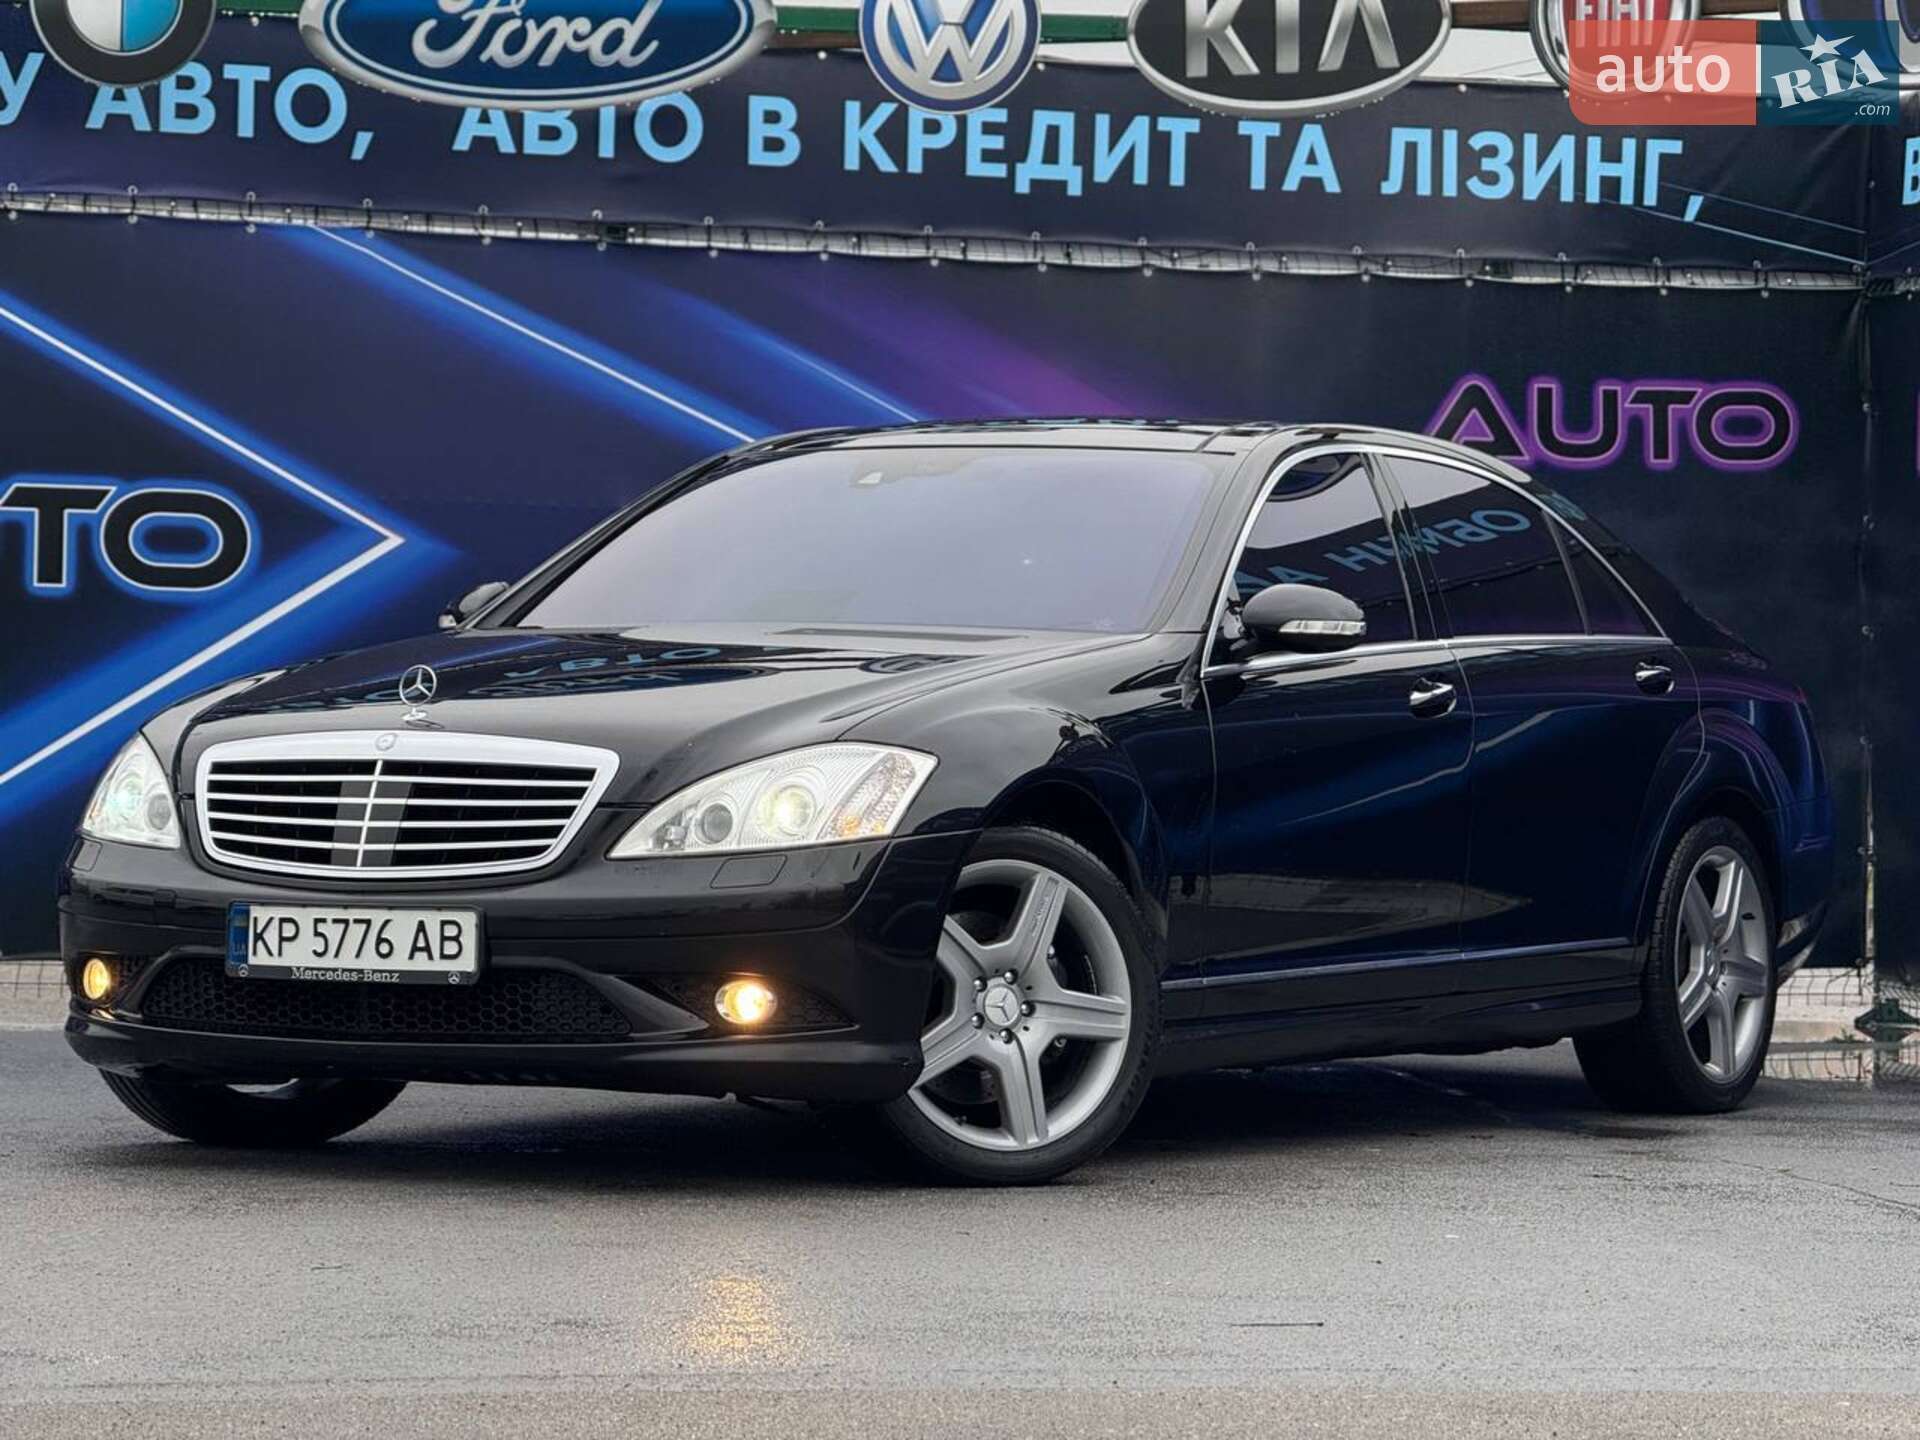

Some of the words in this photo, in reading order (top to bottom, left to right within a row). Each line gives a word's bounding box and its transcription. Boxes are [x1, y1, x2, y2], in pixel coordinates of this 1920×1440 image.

[411, 0, 661, 68] Ford
[85, 62, 373, 160] АВТО,
[748, 95, 800, 167] В
[843, 100, 1200, 196] КРЕДИТ
[1237, 121, 1341, 193] ТА
[1380, 127, 1704, 222] ЛІЗИНГ,
[1428, 378, 1796, 464] AUTO
[252, 916, 300, 957] KP
[312, 917, 394, 959] 5776
[408, 919, 464, 961] AB
[291, 966, 400, 983] Mercedes-Benz
